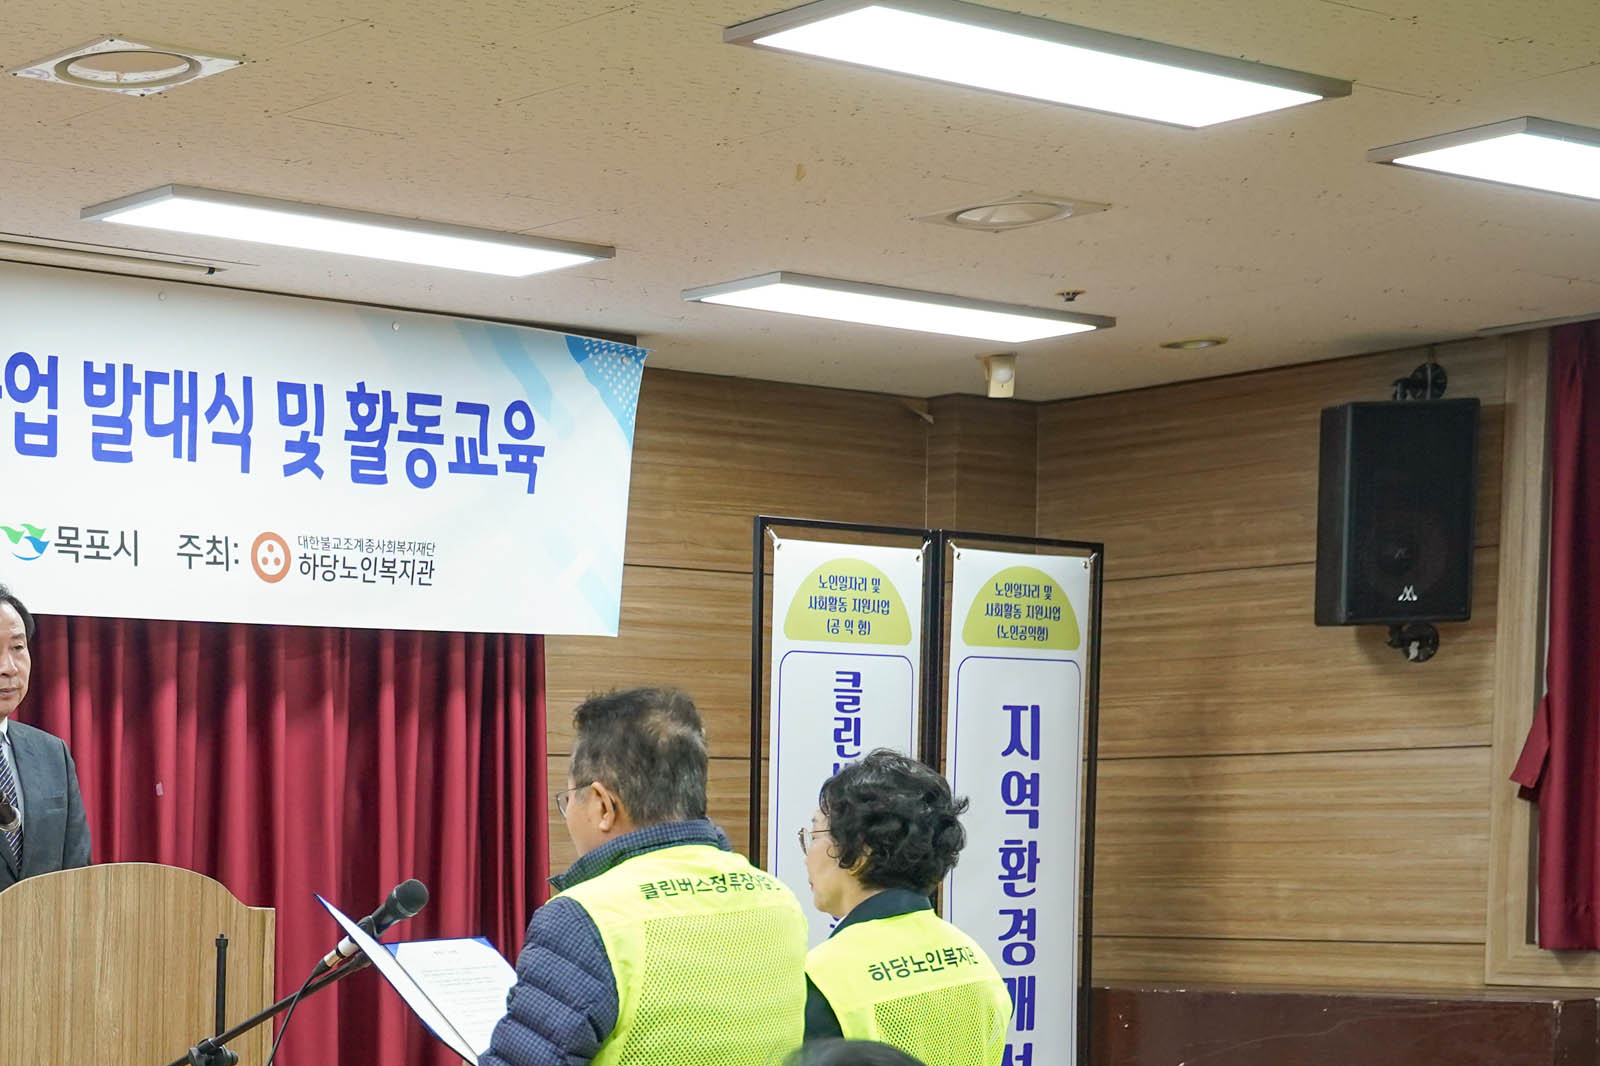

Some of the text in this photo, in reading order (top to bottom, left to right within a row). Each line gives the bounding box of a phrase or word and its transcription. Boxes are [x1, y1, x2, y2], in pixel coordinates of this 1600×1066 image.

[83, 360, 254, 474] 발대식
[276, 381, 325, 480] 및
[344, 381, 545, 494] 활동교육
[54, 526, 139, 567] 목포시
[176, 534, 239, 572] 주최:
[298, 535, 435, 556] 대한불교조계종사회복지재단
[298, 553, 435, 586] 하당노인복지관
[819, 575, 881, 593] 노인일자리 및
[995, 582, 1052, 600] 노인일자리 및
[808, 595, 890, 615] 사회활동 지원사업
[985, 603, 1060, 621] 사회활동 지원사업
[997, 624, 1048, 641] (노인공익형)
